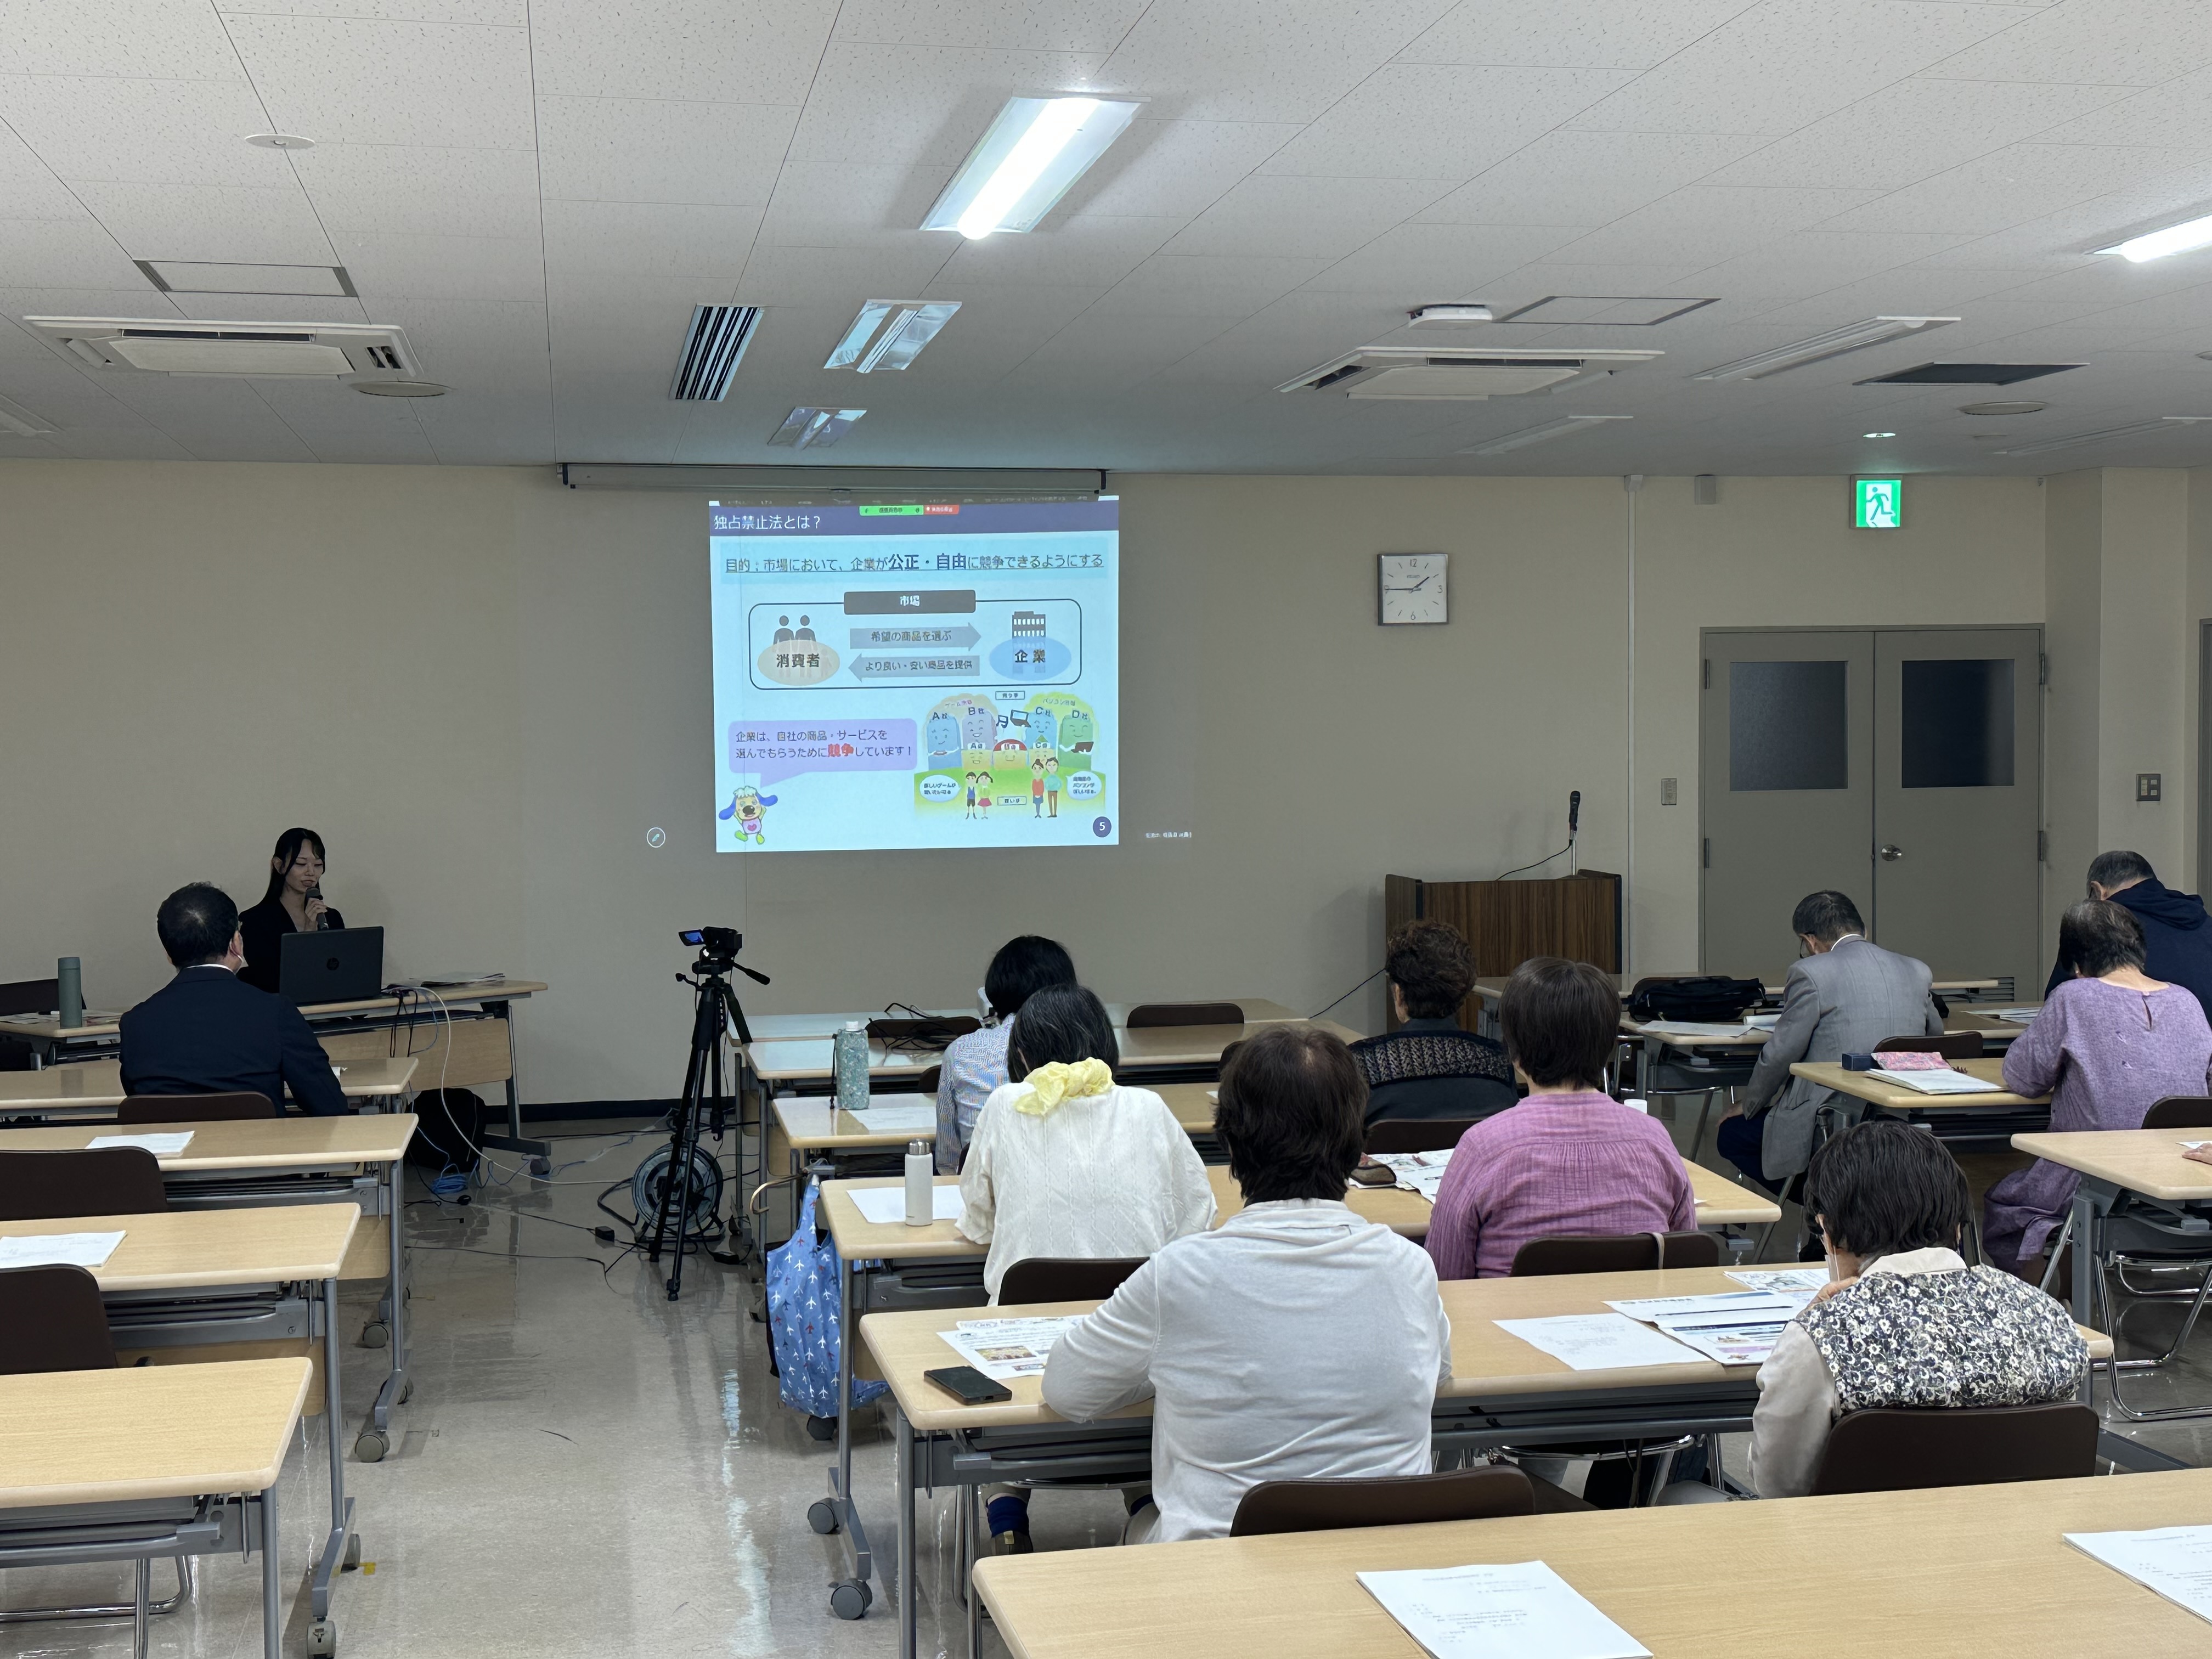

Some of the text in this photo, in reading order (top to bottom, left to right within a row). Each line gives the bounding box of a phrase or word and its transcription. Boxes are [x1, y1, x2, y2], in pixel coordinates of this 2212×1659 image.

[713, 515, 821, 530] 独占禁止法とは？
[1410, 559, 1418, 567] 12
[1437, 585, 1443, 594] 3
[1410, 612, 1416, 620] 6
[871, 630, 952, 642] 希望の商品を選ぶ
[776, 653, 820, 668] 消費者
[736, 729, 888, 742] 企業は、自社の商品・サービスを
[1099, 821, 1106, 832] 5
